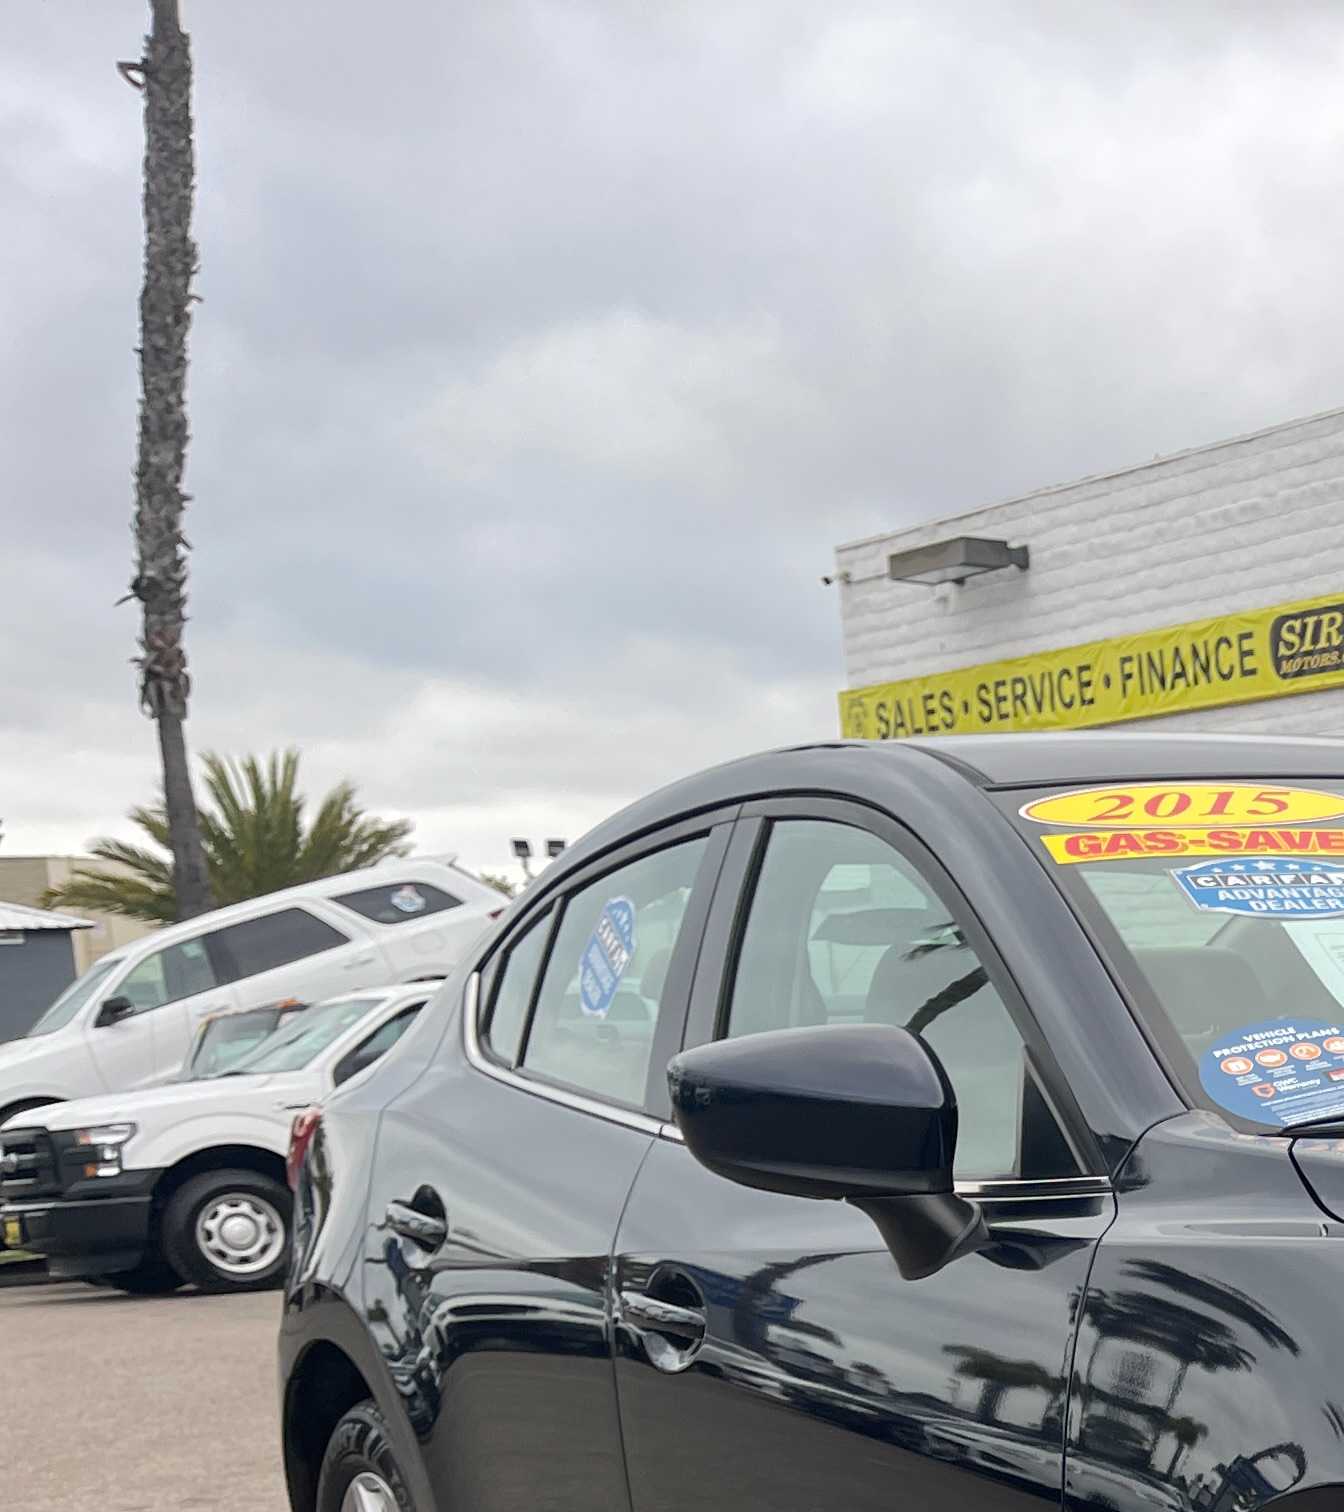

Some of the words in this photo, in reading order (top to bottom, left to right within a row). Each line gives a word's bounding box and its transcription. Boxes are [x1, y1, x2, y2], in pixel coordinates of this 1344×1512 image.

[874, 700, 958, 740] SALES
[977, 665, 1095, 723] SERVICE
[1119, 632, 1257, 697] FINANCE
[1086, 791, 1291, 821] 2015
[1213, 1035, 1296, 1058] PROTECTION
[1296, 1027, 1341, 1041] PLANS
[1242, 1026, 1297, 1043] VEHICLE
